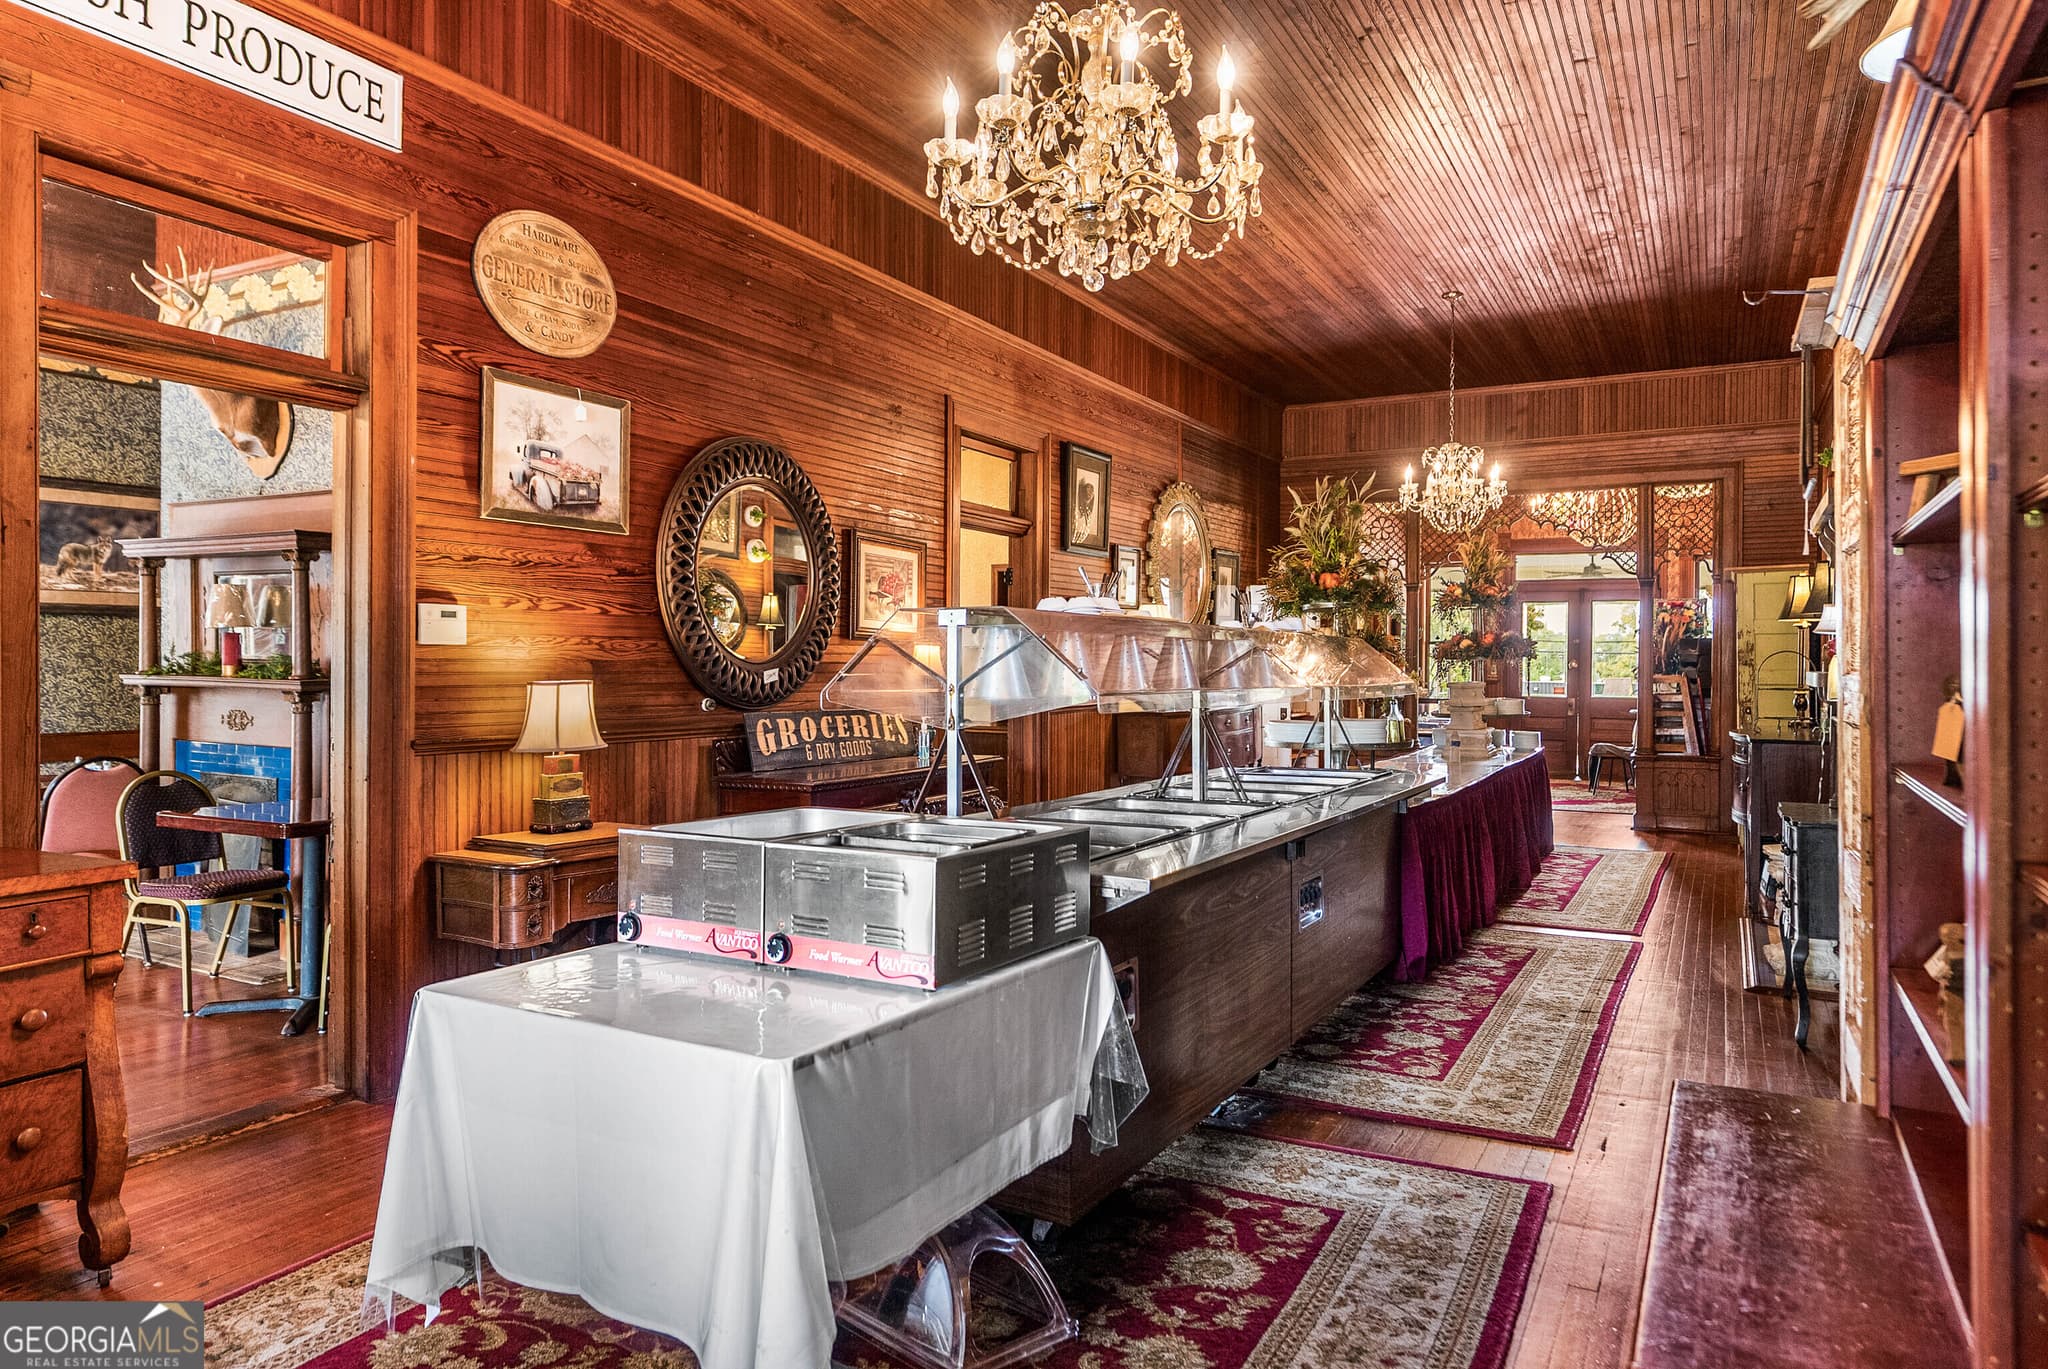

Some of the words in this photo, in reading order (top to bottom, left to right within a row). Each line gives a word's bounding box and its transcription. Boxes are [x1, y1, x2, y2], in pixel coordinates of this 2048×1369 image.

[182, 0, 384, 123] PRODUCE
[522, 223, 581, 254] HARDWARE
[557, 255, 565, 264] &
[481, 254, 558, 299] GENERAL
[564, 280, 613, 316] STORE
[524, 321, 535, 334] &
[541, 326, 575, 345] CANDY
[756, 713, 909, 757] GROCERIES
[805, 744, 813, 761] &
[816, 743, 836, 760] DRY
[840, 740, 873, 757] GOODS
[809, 948, 830, 961] Food
[831, 951, 863, 966] Warmer
